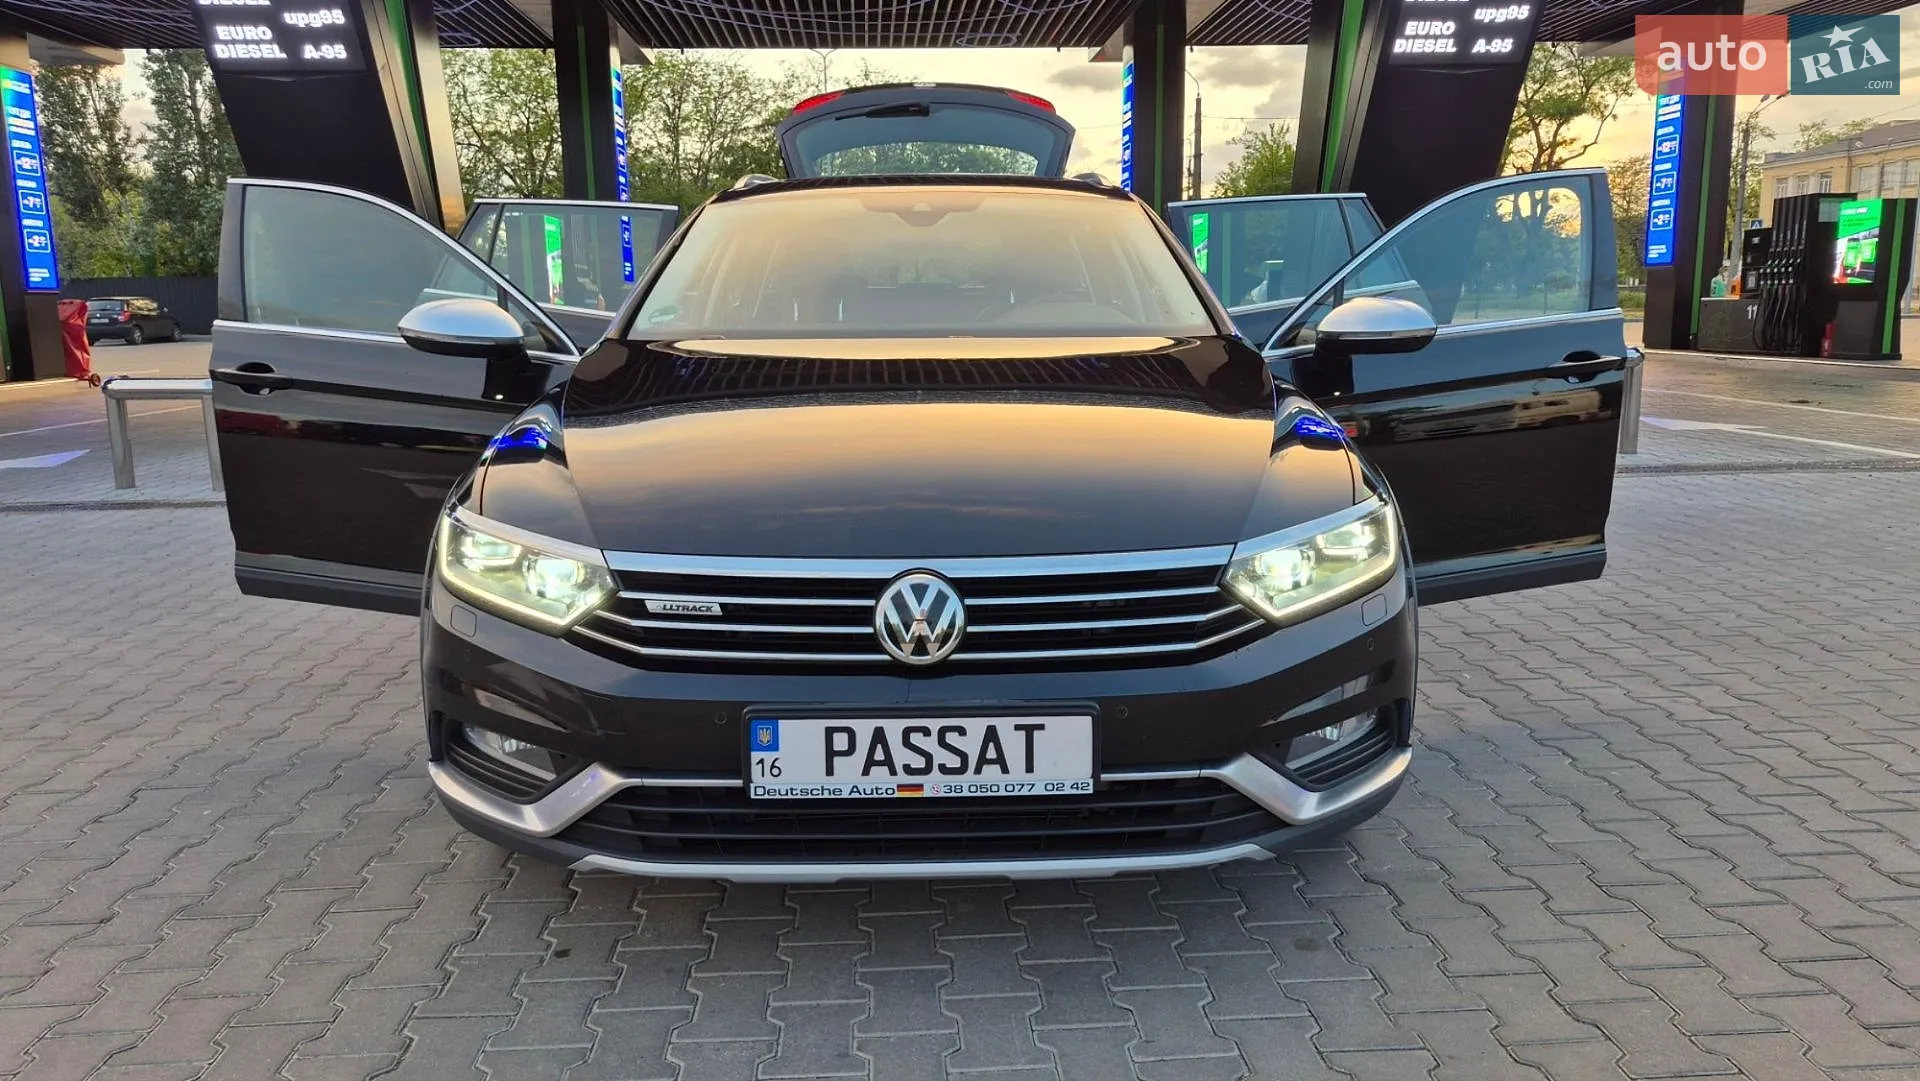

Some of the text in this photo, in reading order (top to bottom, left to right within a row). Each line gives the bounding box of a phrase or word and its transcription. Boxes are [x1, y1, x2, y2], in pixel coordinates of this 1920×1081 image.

[283, 9, 345, 27] upg95
[1474, 5, 1530, 22] upg95
[215, 25, 273, 40] EURO
[1404, 21, 1456, 36] EURO
[213, 44, 287, 59] DIESEL
[303, 44, 347, 59] A-95
[1393, 38, 1457, 53] DIESEL
[1471, 38, 1513, 53] A-95
[824, 723, 1045, 777] PASSAT
[755, 757, 782, 777] 16
[754, 781, 1090, 796] Deutsche Auto 38 050 077 02 42
